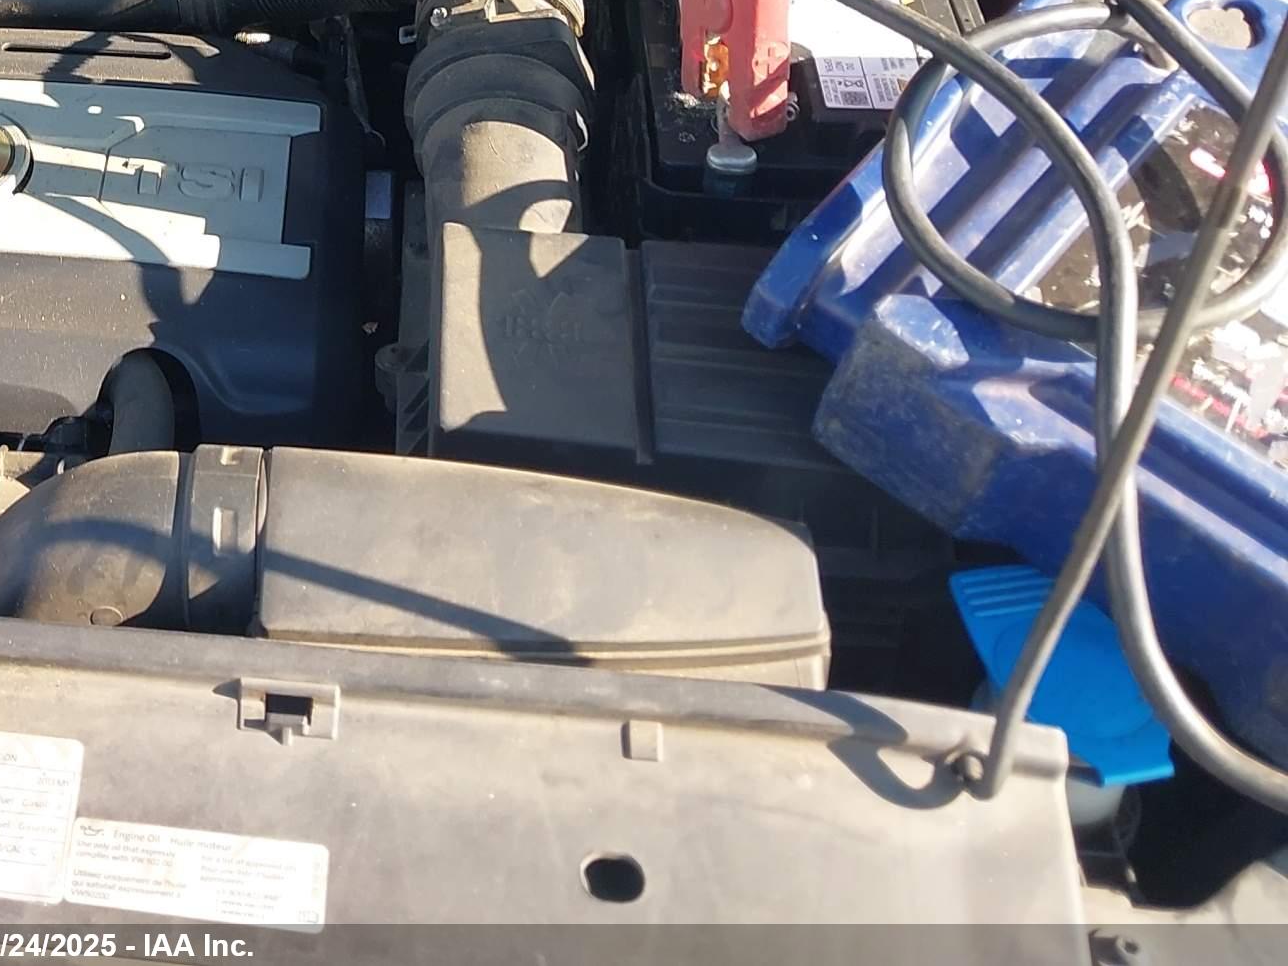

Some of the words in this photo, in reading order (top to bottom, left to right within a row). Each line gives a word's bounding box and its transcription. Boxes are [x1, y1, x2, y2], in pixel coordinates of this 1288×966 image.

[123, 159, 265, 203] TSI
[113, 829, 146, 843] Engine
[146, 833, 161, 843] Oil
